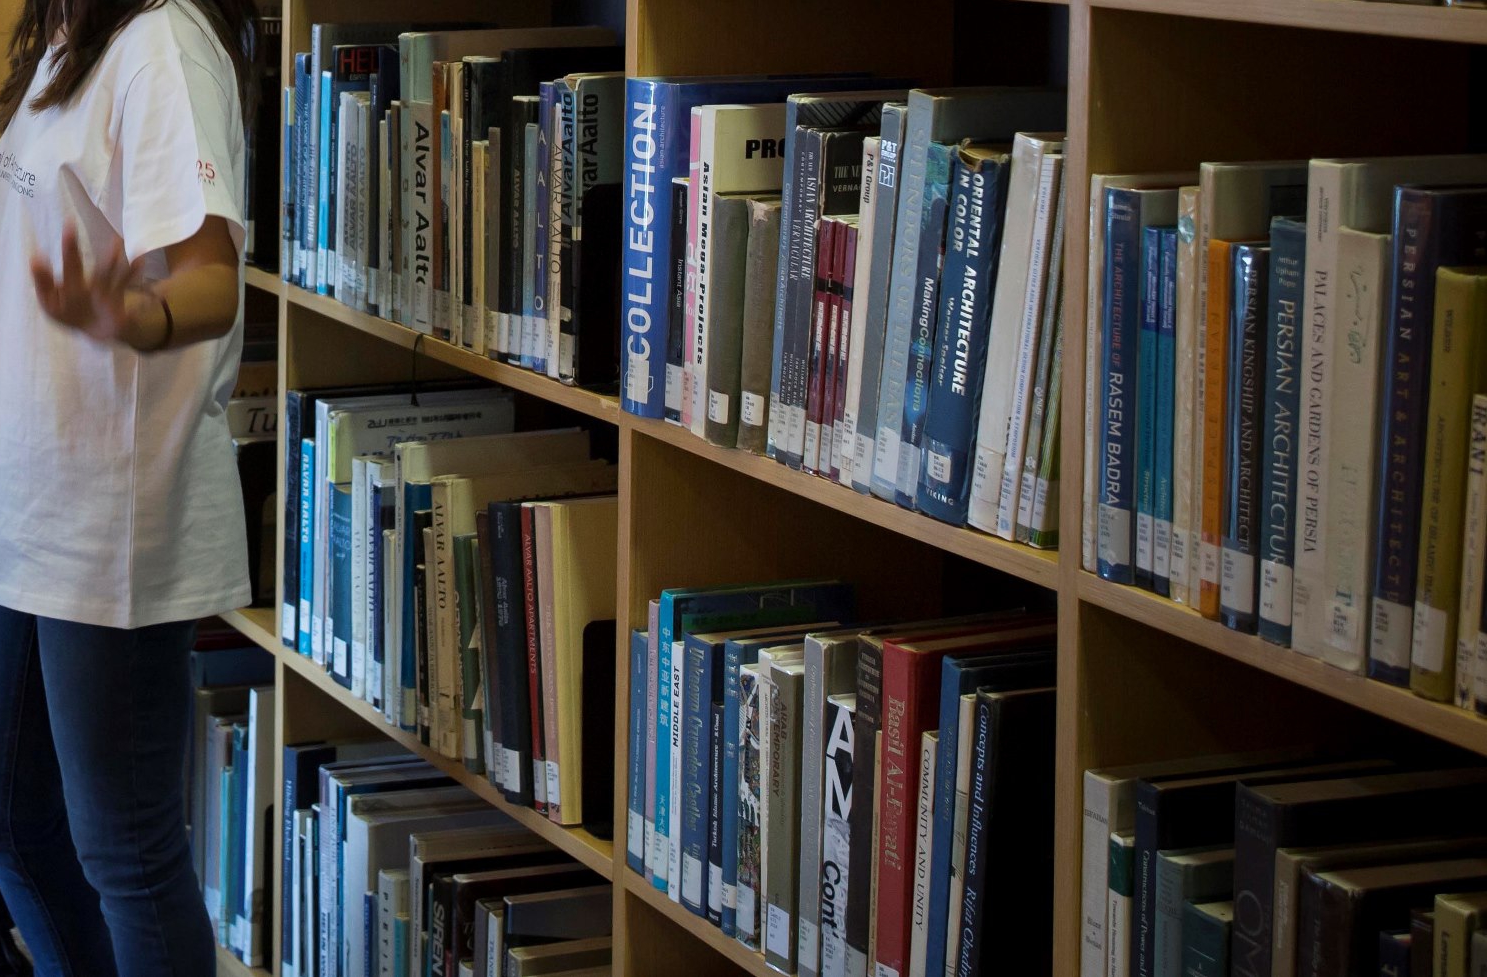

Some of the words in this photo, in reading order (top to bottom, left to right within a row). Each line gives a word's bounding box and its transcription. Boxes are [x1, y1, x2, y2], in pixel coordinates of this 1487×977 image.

[562, 93, 573, 159] Aalto
[581, 93, 599, 156] Aalto
[412, 121, 430, 204] Alvar
[551, 143, 562, 204] ALVAR
[561, 161, 573, 220] Alvar
[702, 161, 710, 219] Asian
[807, 176, 818, 207] ASIAN
[863, 175, 871, 204] Group
[533, 131, 547, 312] AALTO
[550, 210, 562, 275] AALTO
[626, 101, 657, 368] COLLECTION
[780, 182, 789, 250] Contemporary
[800, 207, 815, 281] ARCHITECTURE
[951, 186, 969, 254] COLOR
[965, 171, 985, 260] ORIENTAL
[676, 257, 684, 285] Instant
[789, 218, 801, 281] VERNACULAR
[1115, 242, 1125, 263] THE
[675, 287, 684, 308] Asia
[1112, 265, 1124, 350] ARCHITECTURE
[1244, 268, 1258, 337] PERSIAN
[1278, 277, 1297, 289] Pope
[1313, 269, 1328, 346] PALACES
[1398, 226, 1418, 342] PERSIAN
[950, 263, 978, 397] ARCHITECTURE
[1272, 298, 1295, 395] PERSIAN
[1241, 338, 1256, 417] KINGSHIP
[1311, 348, 1326, 385] AND
[1395, 352, 1411, 400] ART
[1107, 370, 1124, 437] RASEM
[1307, 385, 1325, 466] GARDENS
[1240, 418, 1253, 453] AND
[302, 453, 310, 491] ALVAR
[925, 486, 955, 506] VIKING
[1105, 442, 1122, 506] BADRA
[301, 495, 310, 544] AALTO
[434, 501, 444, 553] ALVAR
[524, 533, 532, 565] ALVAR
[1302, 493, 1318, 554] PERSIA
[435, 555, 446, 611] AALTO
[525, 565, 534, 602] AALTO
[527, 603, 537, 675] APARTMENTS
[688, 646, 705, 713] Unknown
[687, 714, 703, 779] Crusader
[780, 700, 788, 741] ARAB
[887, 694, 906, 758] Basil
[976, 703, 989, 772] Concepts
[919, 748, 931, 844] COMMUNITY
[974, 773, 985, 802] and
[917, 846, 927, 879] AND
[968, 803, 983, 876] Influences
[915, 881, 925, 931] UNITY
[964, 886, 977, 924] Rifat
[1141, 849, 1152, 911] Constructions
